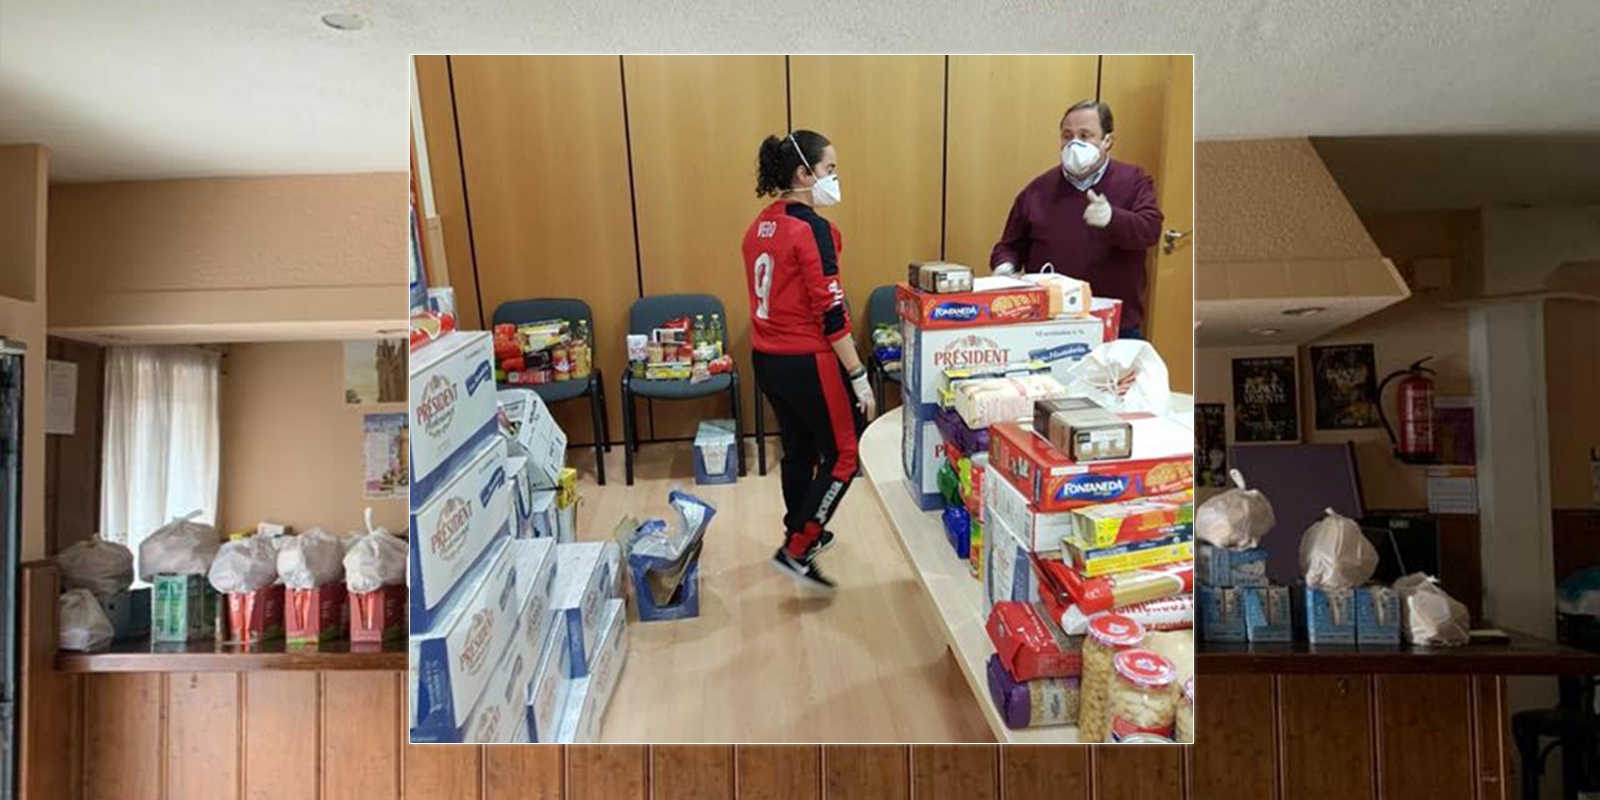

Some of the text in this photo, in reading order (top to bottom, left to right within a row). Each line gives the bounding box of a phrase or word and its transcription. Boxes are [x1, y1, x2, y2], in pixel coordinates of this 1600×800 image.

[757, 221, 777, 237] VERO
[754, 252, 774, 319] 9
[935, 305, 978, 318] FONTANEDA
[934, 348, 1010, 367] PRÉSIDENT
[1063, 478, 1124, 496] FONTANEDA
